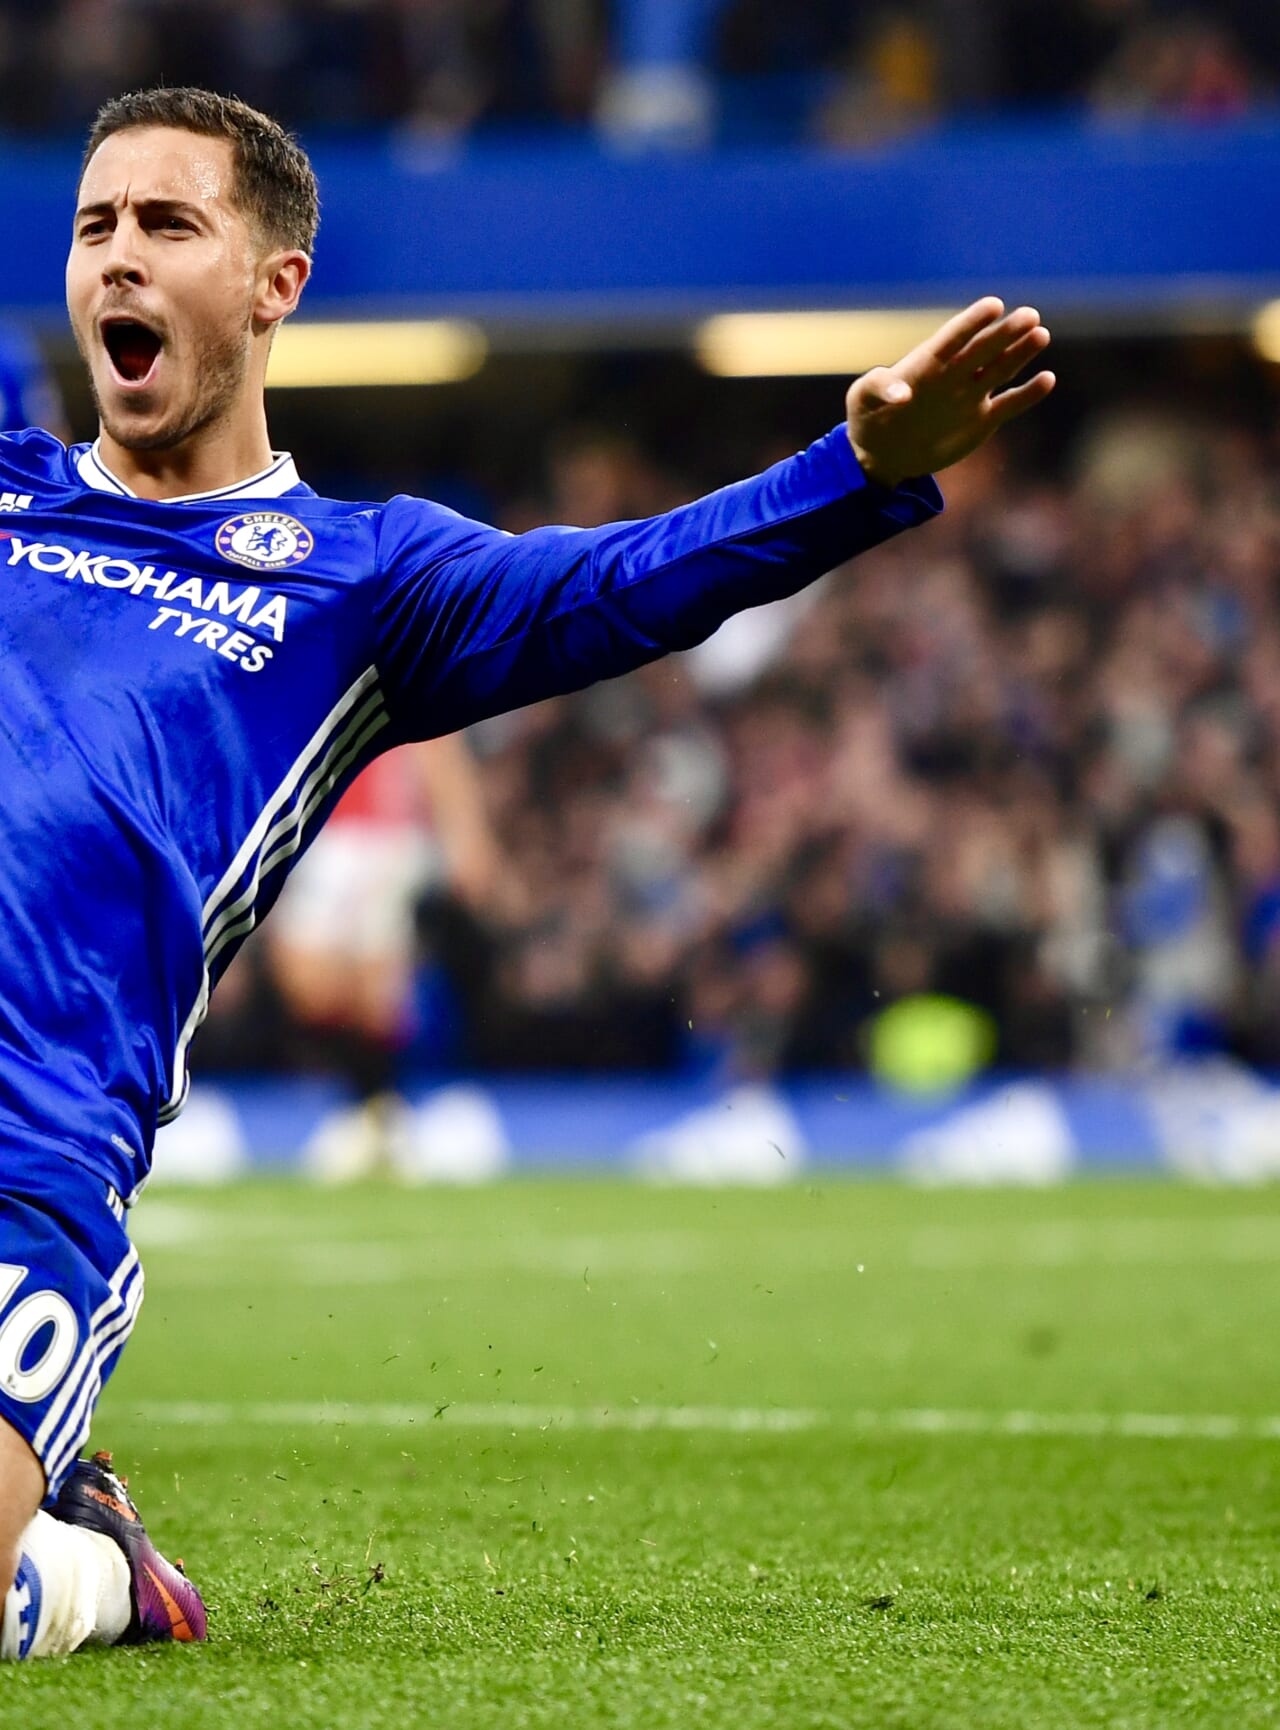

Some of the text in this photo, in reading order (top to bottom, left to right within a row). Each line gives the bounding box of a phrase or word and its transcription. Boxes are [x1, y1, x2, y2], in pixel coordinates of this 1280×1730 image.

[243, 514, 302, 536] CHELSEA
[6, 538, 287, 643] YOKOHAMA
[147, 607, 273, 673] TYRES
